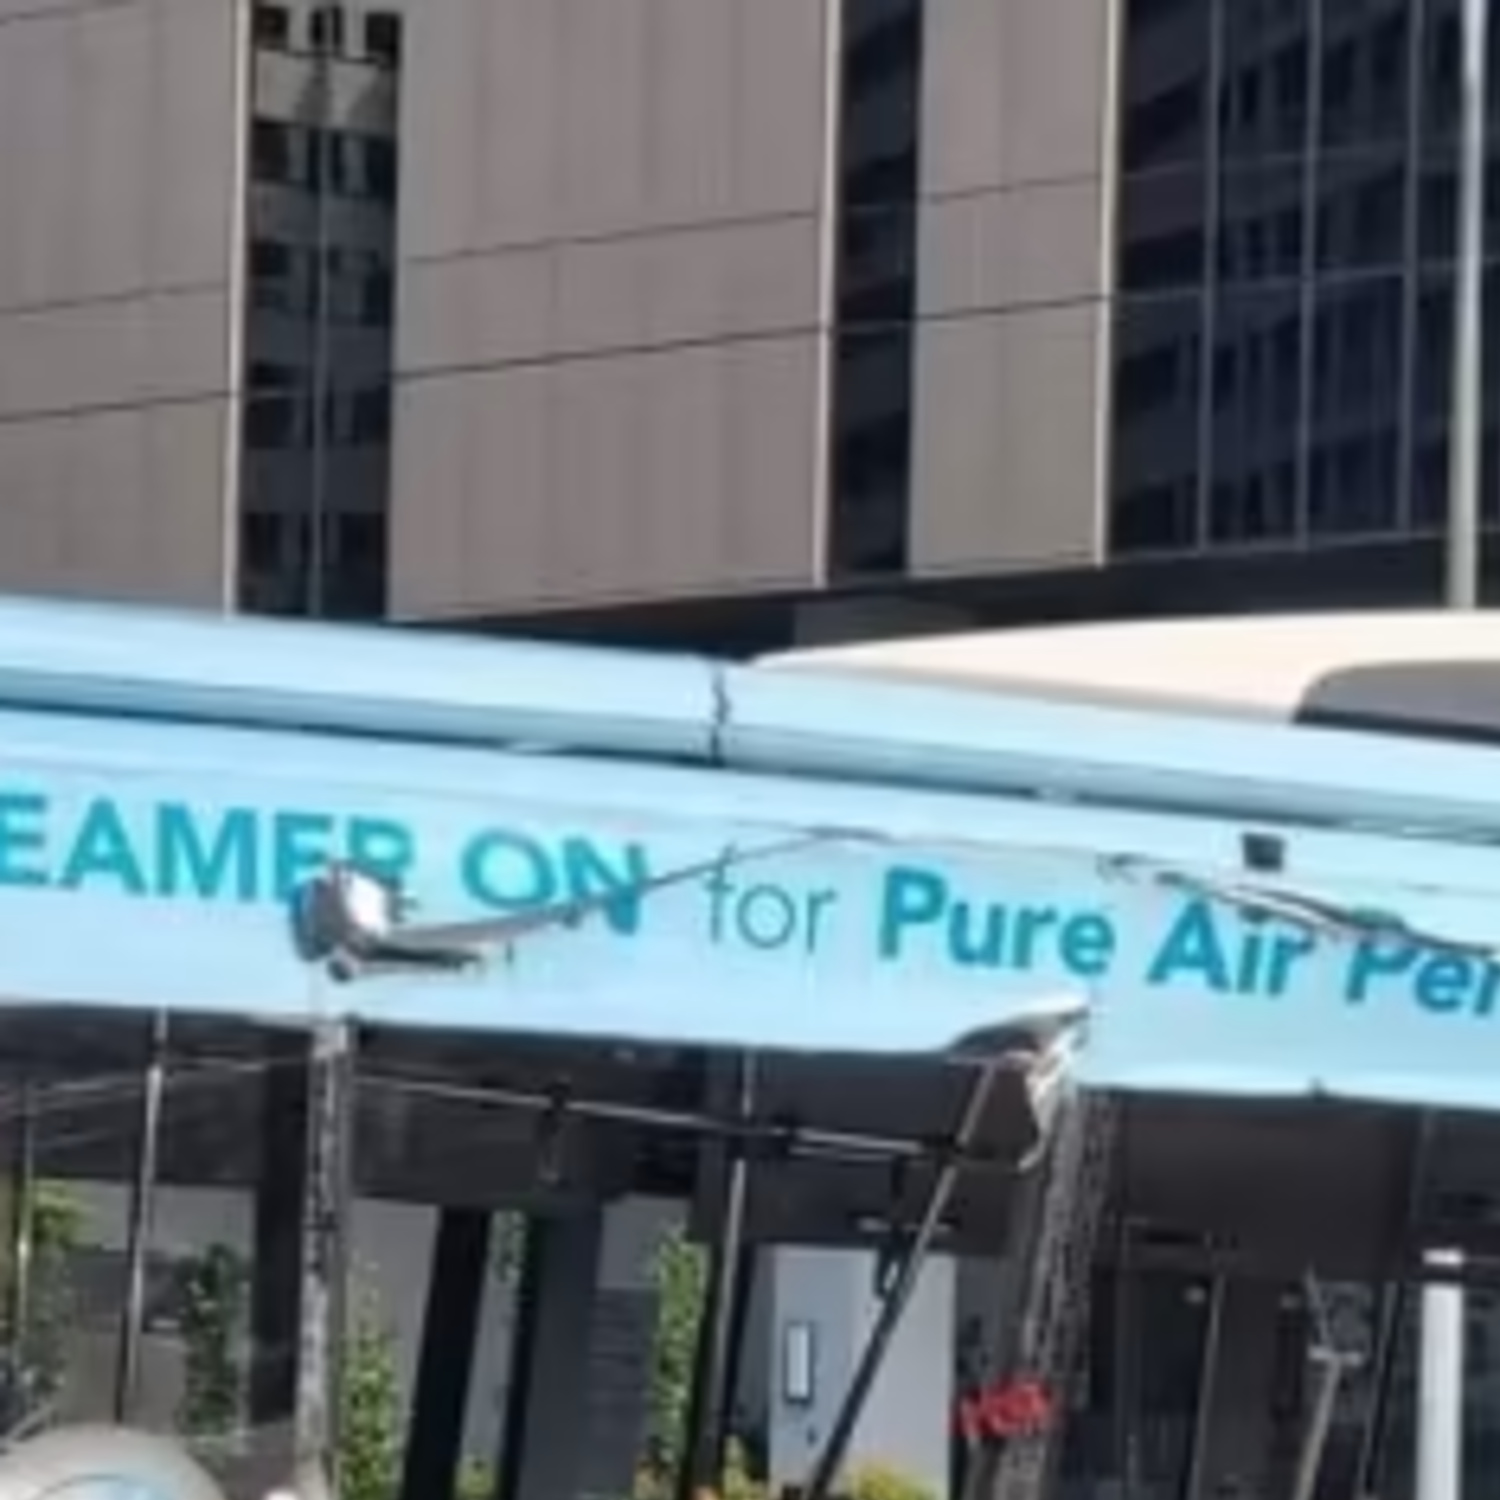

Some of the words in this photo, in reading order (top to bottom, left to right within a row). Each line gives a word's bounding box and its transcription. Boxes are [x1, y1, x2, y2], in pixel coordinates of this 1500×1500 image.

[460, 828, 648, 937] ON
[703, 844, 838, 955] for
[877, 865, 1116, 976] Pure
[1147, 892, 1316, 996] Air
